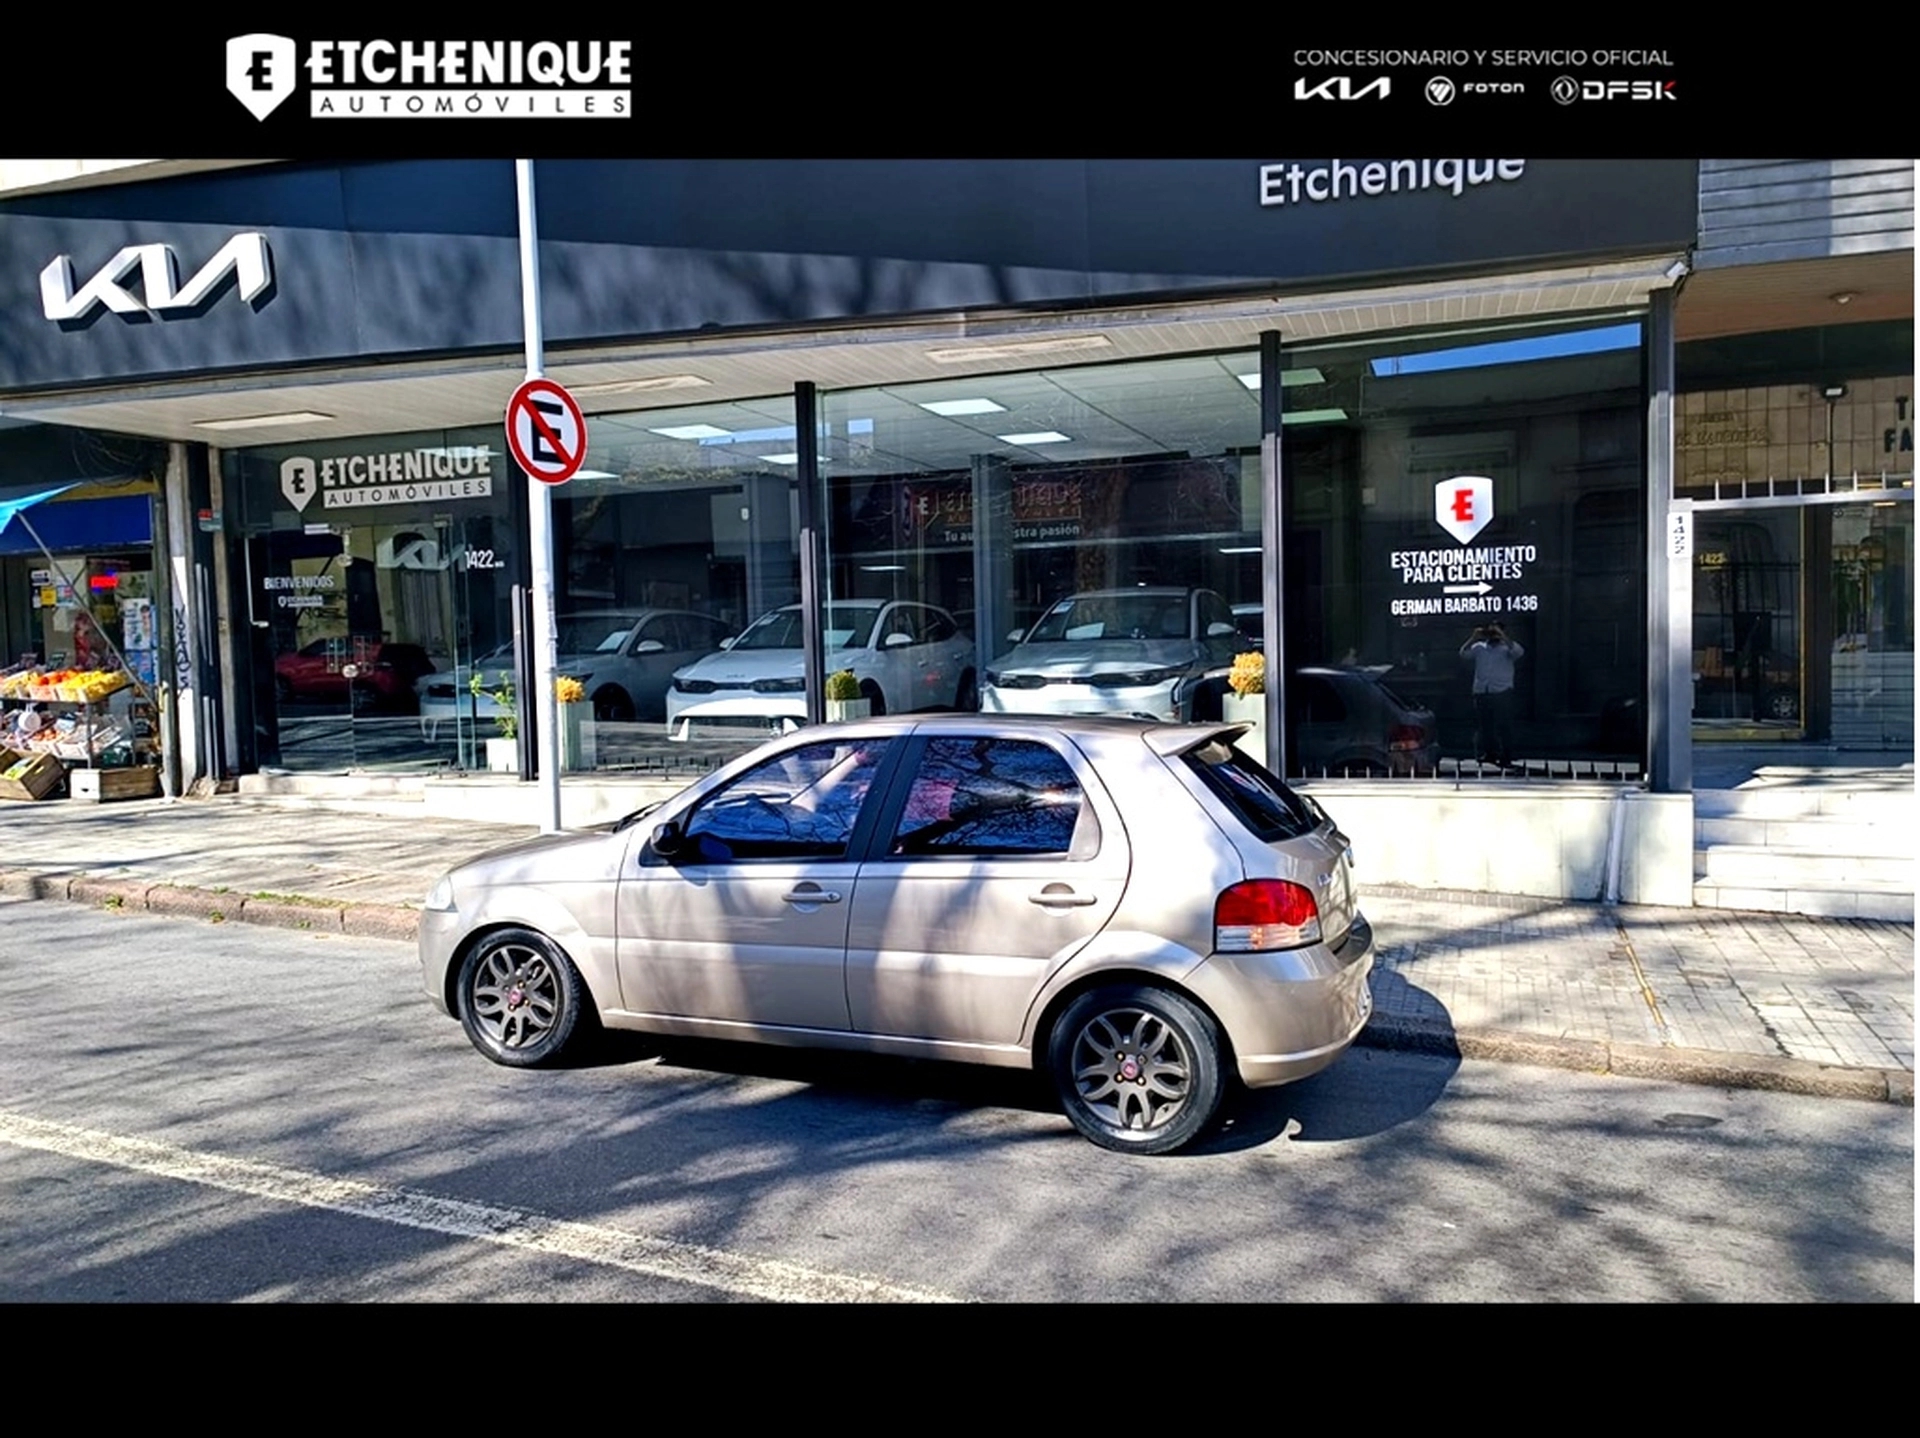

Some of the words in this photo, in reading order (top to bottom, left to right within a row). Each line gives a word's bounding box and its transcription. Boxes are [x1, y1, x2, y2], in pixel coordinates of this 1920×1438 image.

[1260, 159, 1525, 205] Etchenique
[40, 232, 270, 320] KIA
[1895, 396, 1914, 421] T
[530, 400, 565, 464] E
[320, 444, 491, 487] ETCHENIQUE
[328, 480, 488, 506] AUTOMÓVILES
[1040, 523, 1080, 539] pasión
[464, 549, 494, 569] 1422
[1391, 545, 1536, 569] ESTACIONAMIENTO
[263, 575, 334, 590] BIENVENIDOS
[1403, 567, 1444, 584] PARA
[1447, 562, 1523, 582] CLIENTES
[1391, 599, 1442, 616] GERMAN
[1444, 597, 1502, 613] BARBATO
[1505, 595, 1539, 612] 1436
